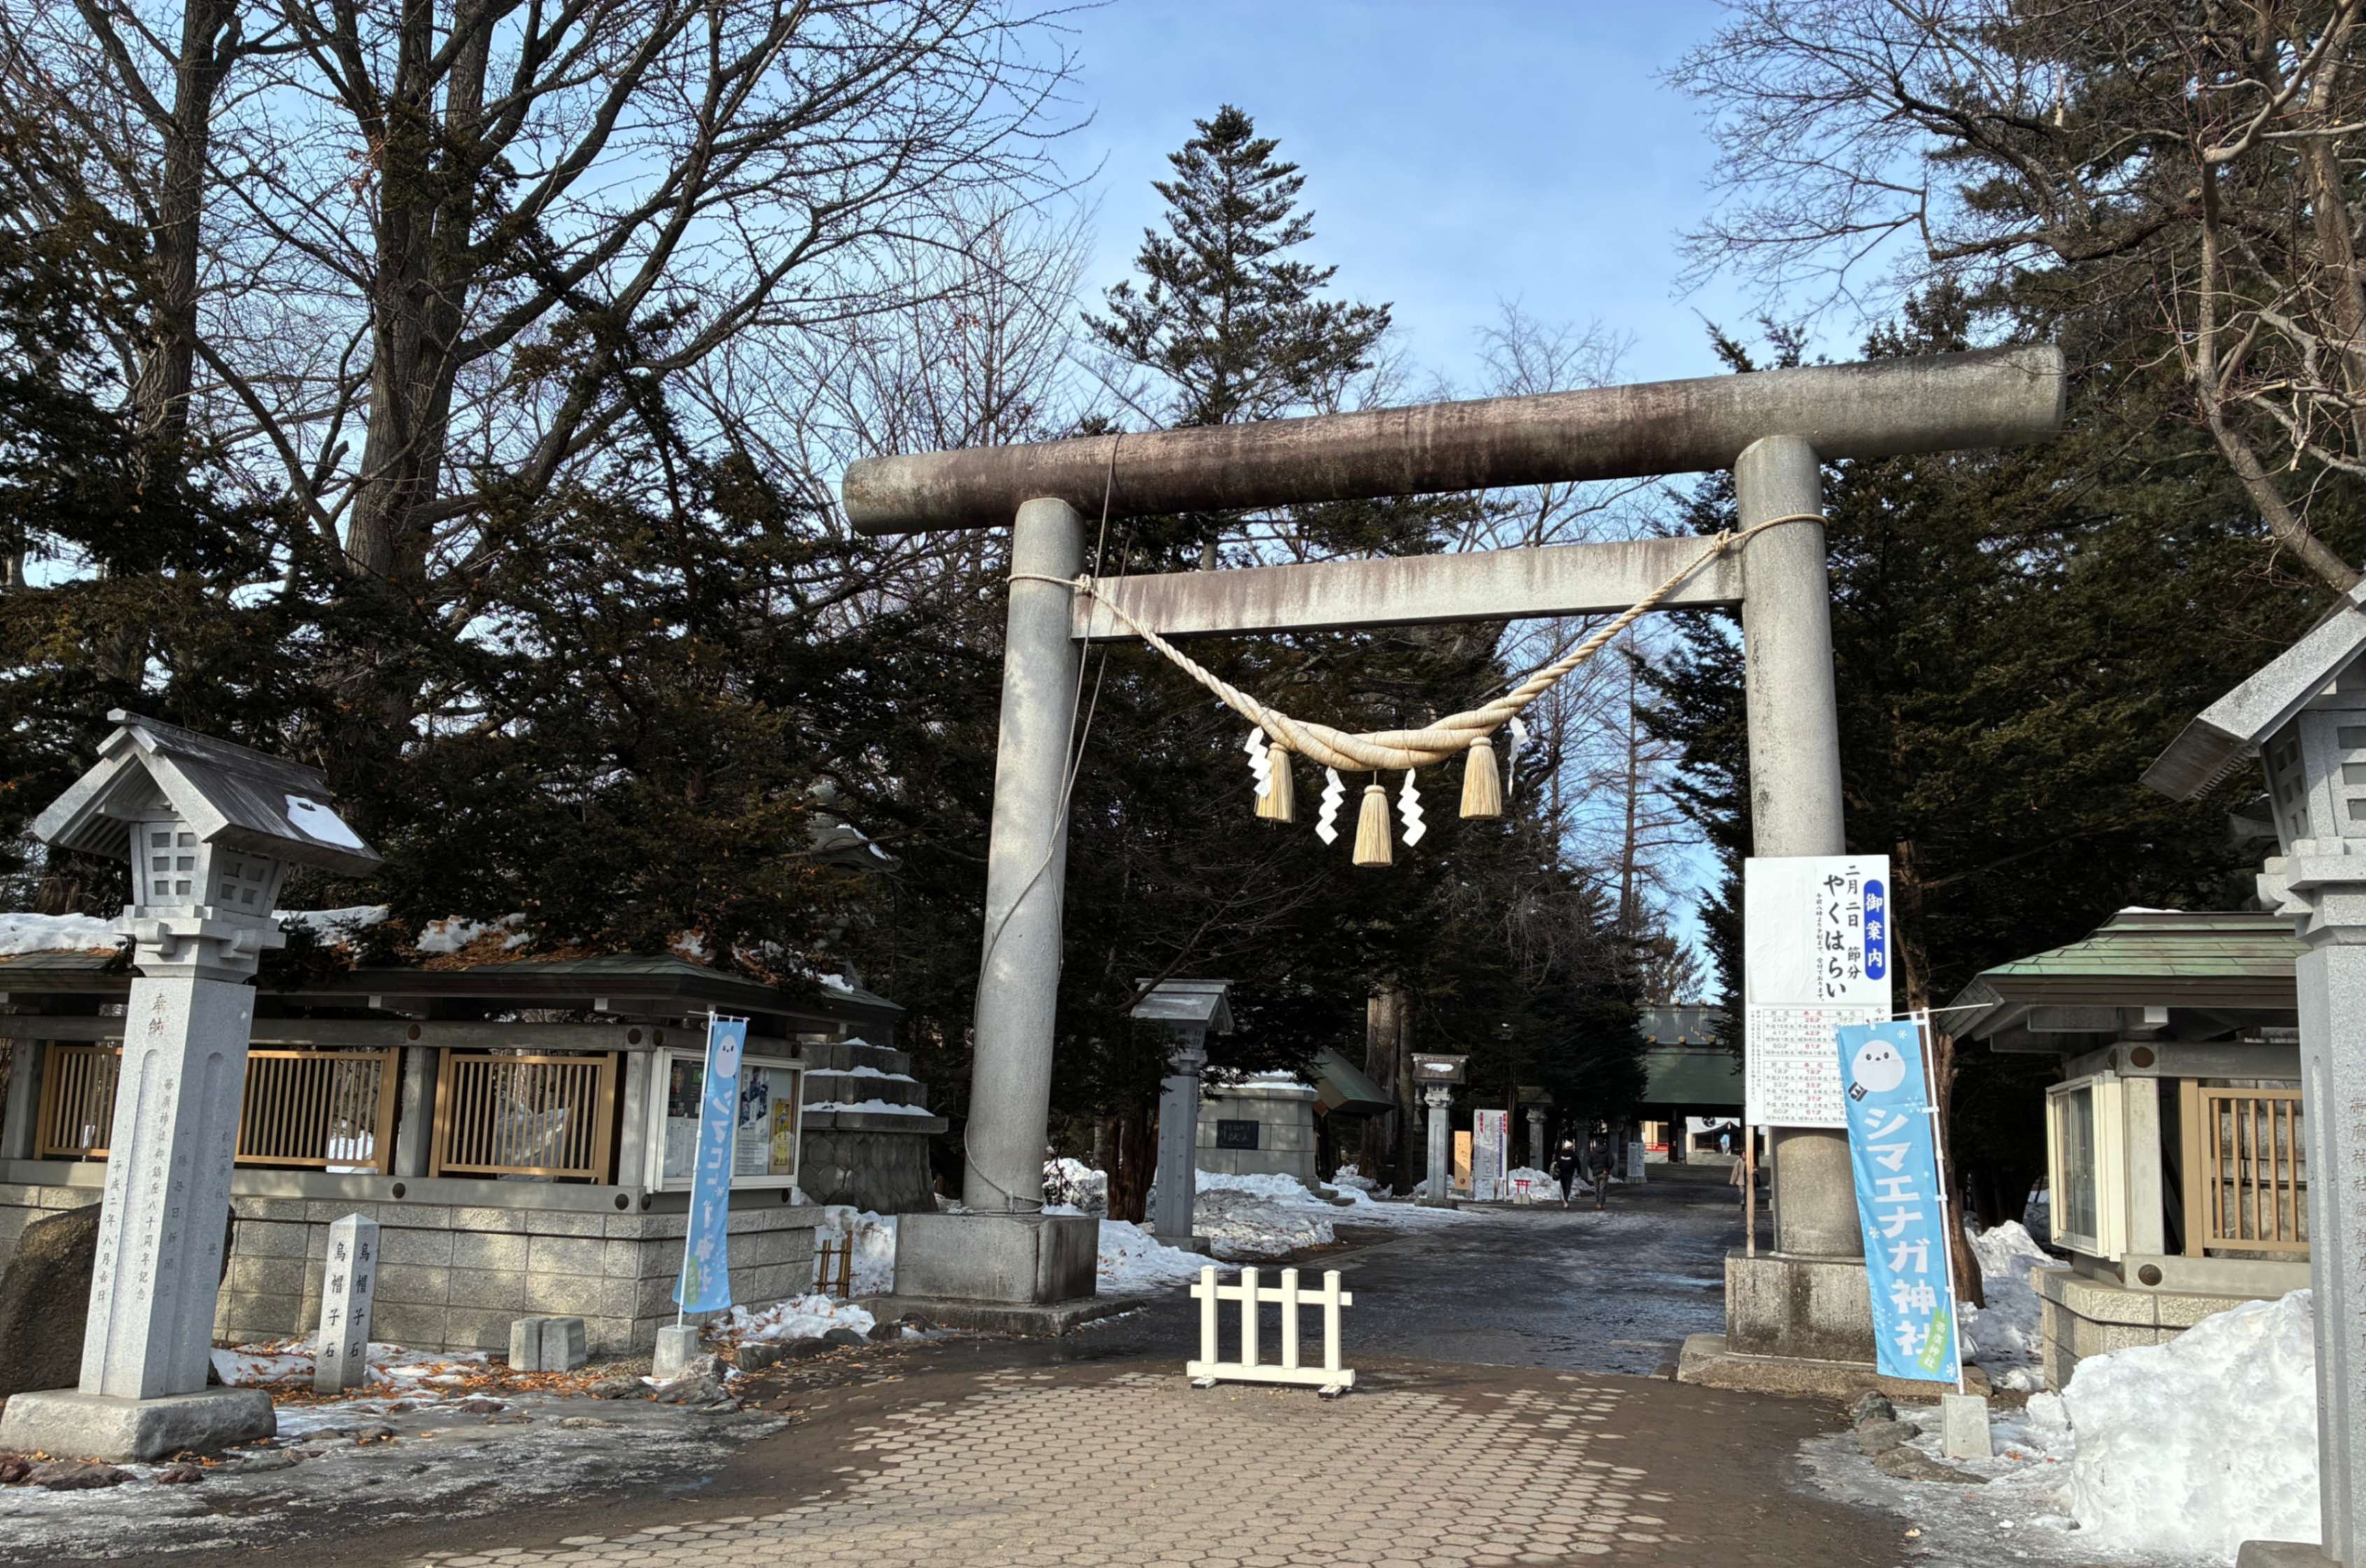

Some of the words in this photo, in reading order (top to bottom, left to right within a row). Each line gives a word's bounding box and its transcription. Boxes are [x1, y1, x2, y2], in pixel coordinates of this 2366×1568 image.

[1823, 874, 1846, 998] やくはらい
[1848, 946, 1862, 980] 節分
[1865, 893, 1883, 969] 御案内
[1864, 1107, 1937, 1357] シマエナガ神社
